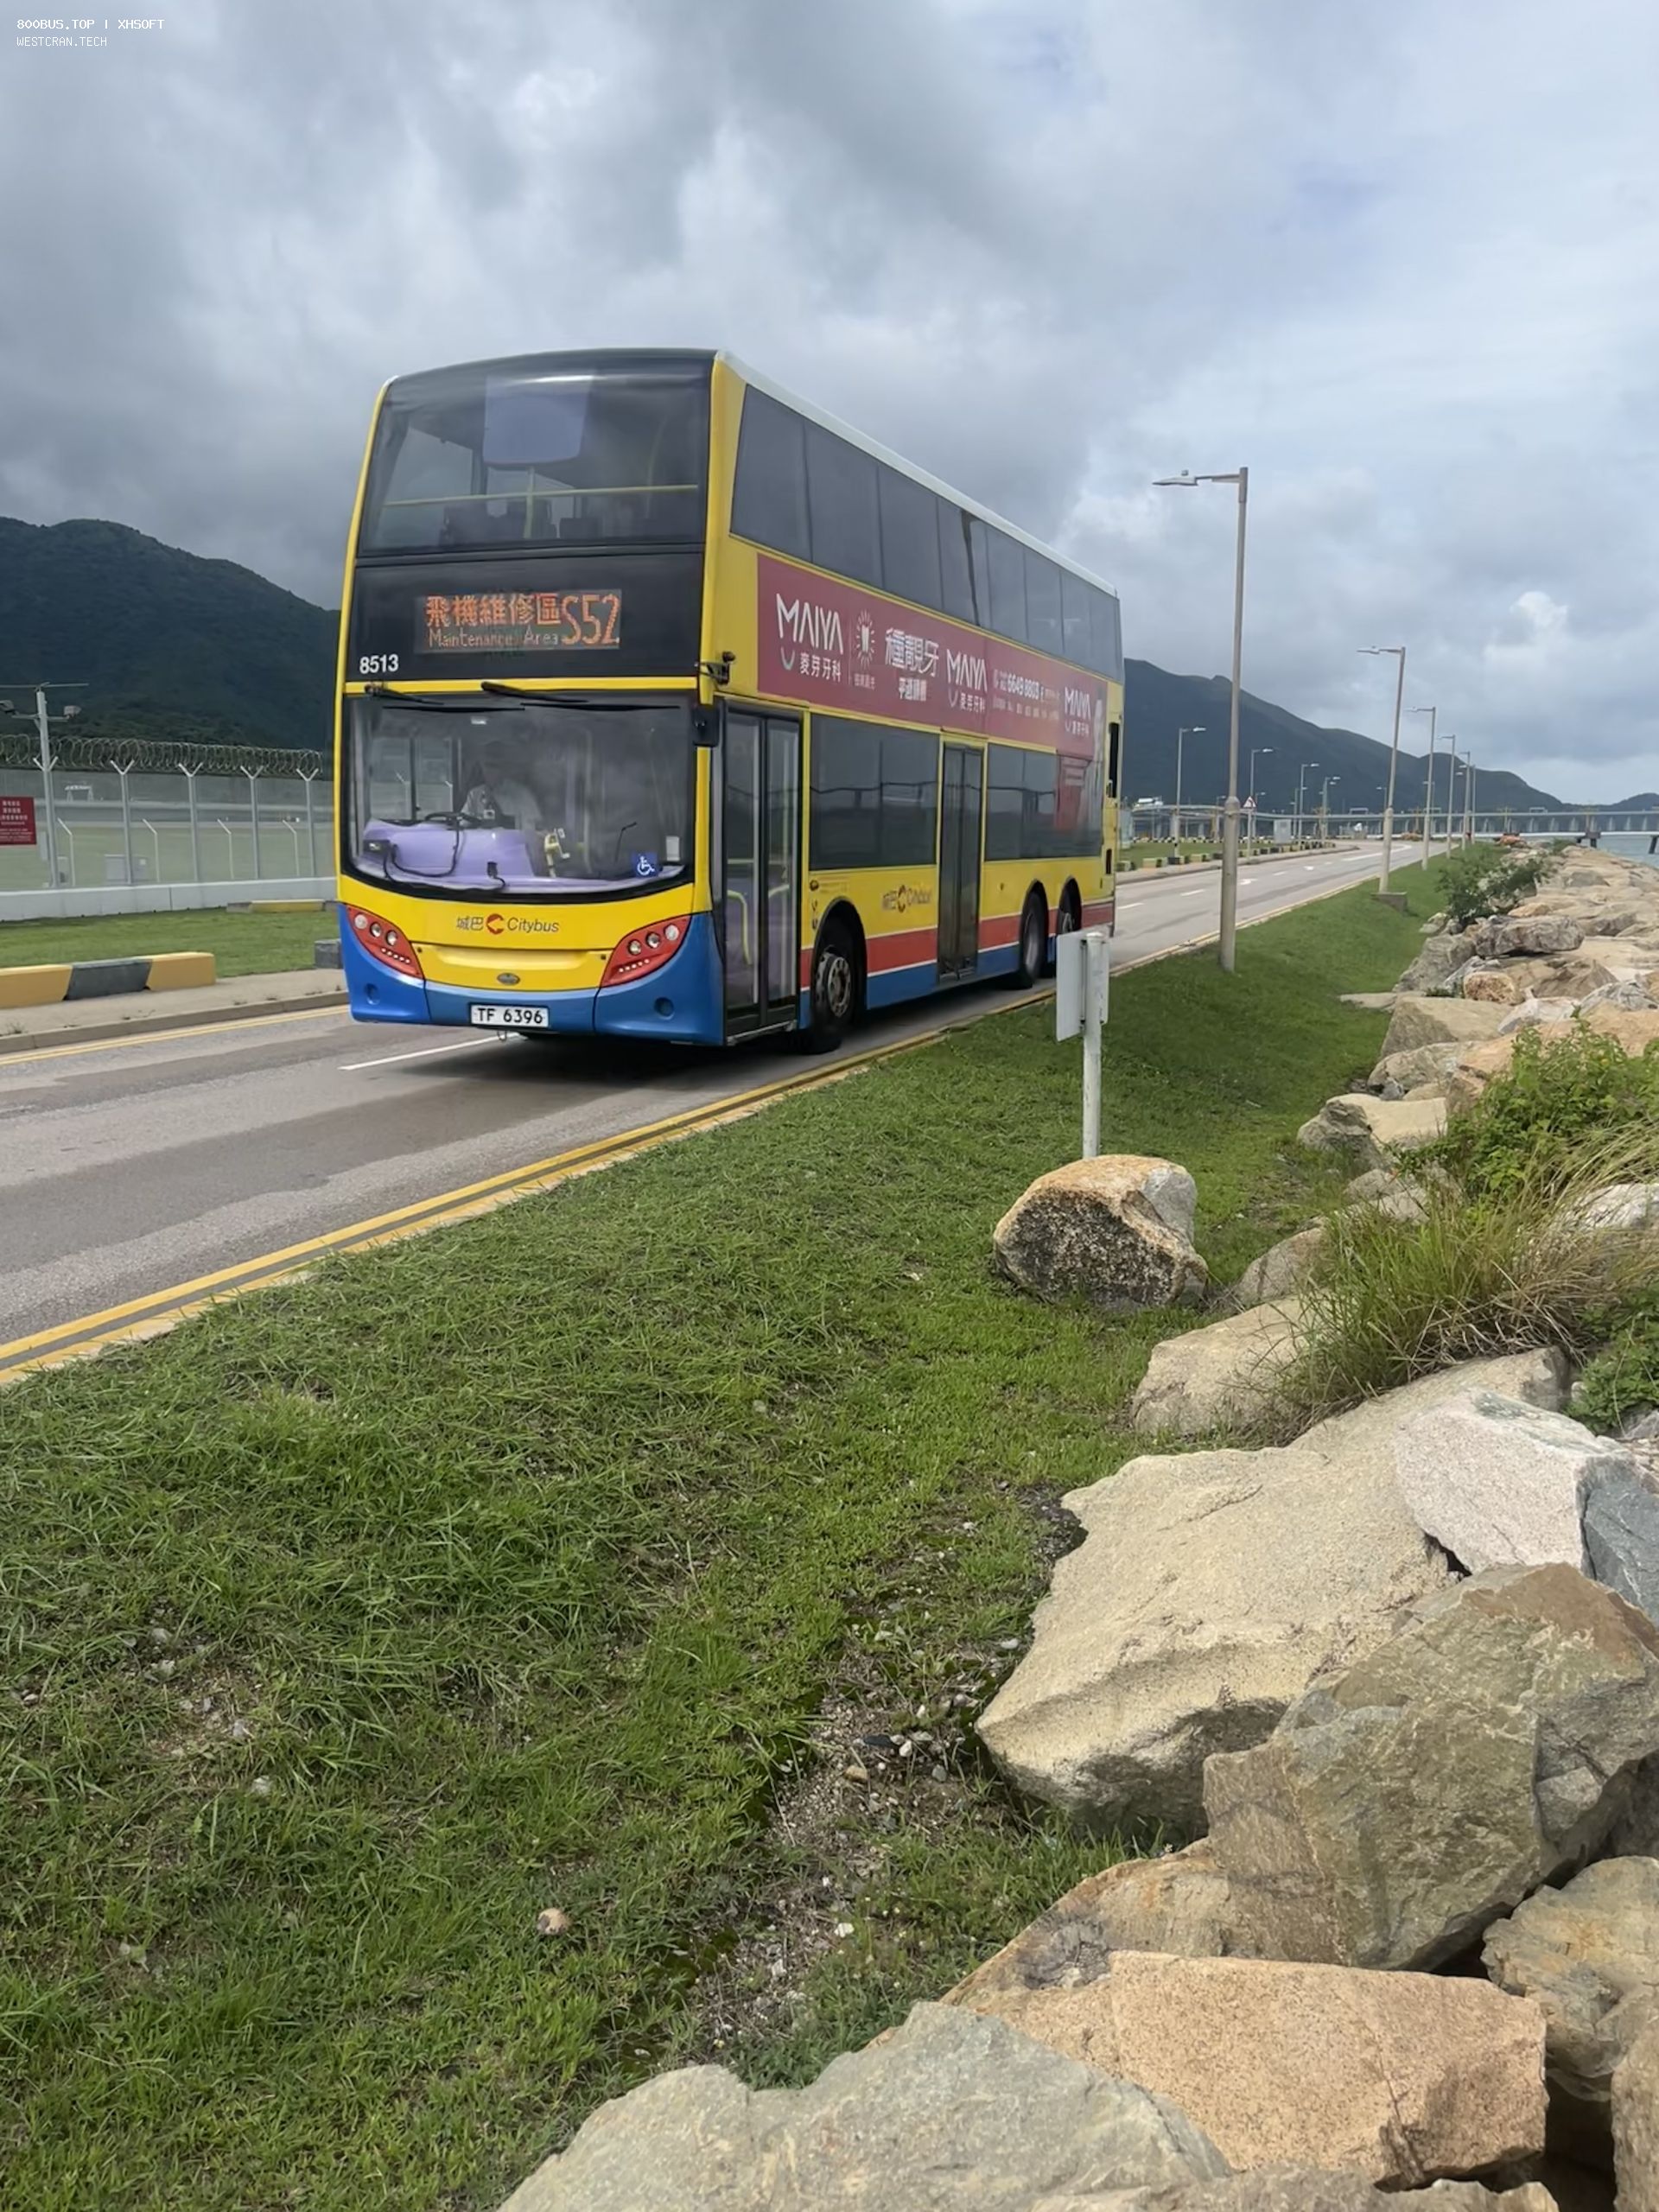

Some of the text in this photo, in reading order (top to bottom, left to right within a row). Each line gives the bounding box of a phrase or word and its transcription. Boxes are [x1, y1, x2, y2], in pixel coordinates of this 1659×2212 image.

[426, 592, 562, 627] 飛機維修區
[562, 594, 620, 645] S52
[776, 593, 844, 656] MAIYA
[524, 625, 558, 646] Area
[359, 653, 399, 674] 8513
[799, 652, 842, 683] 麥芽牙科
[456, 916, 484, 931] 城巴
[506, 916, 560, 934] Citybus
[477, 1007, 543, 1024] TF 6396
